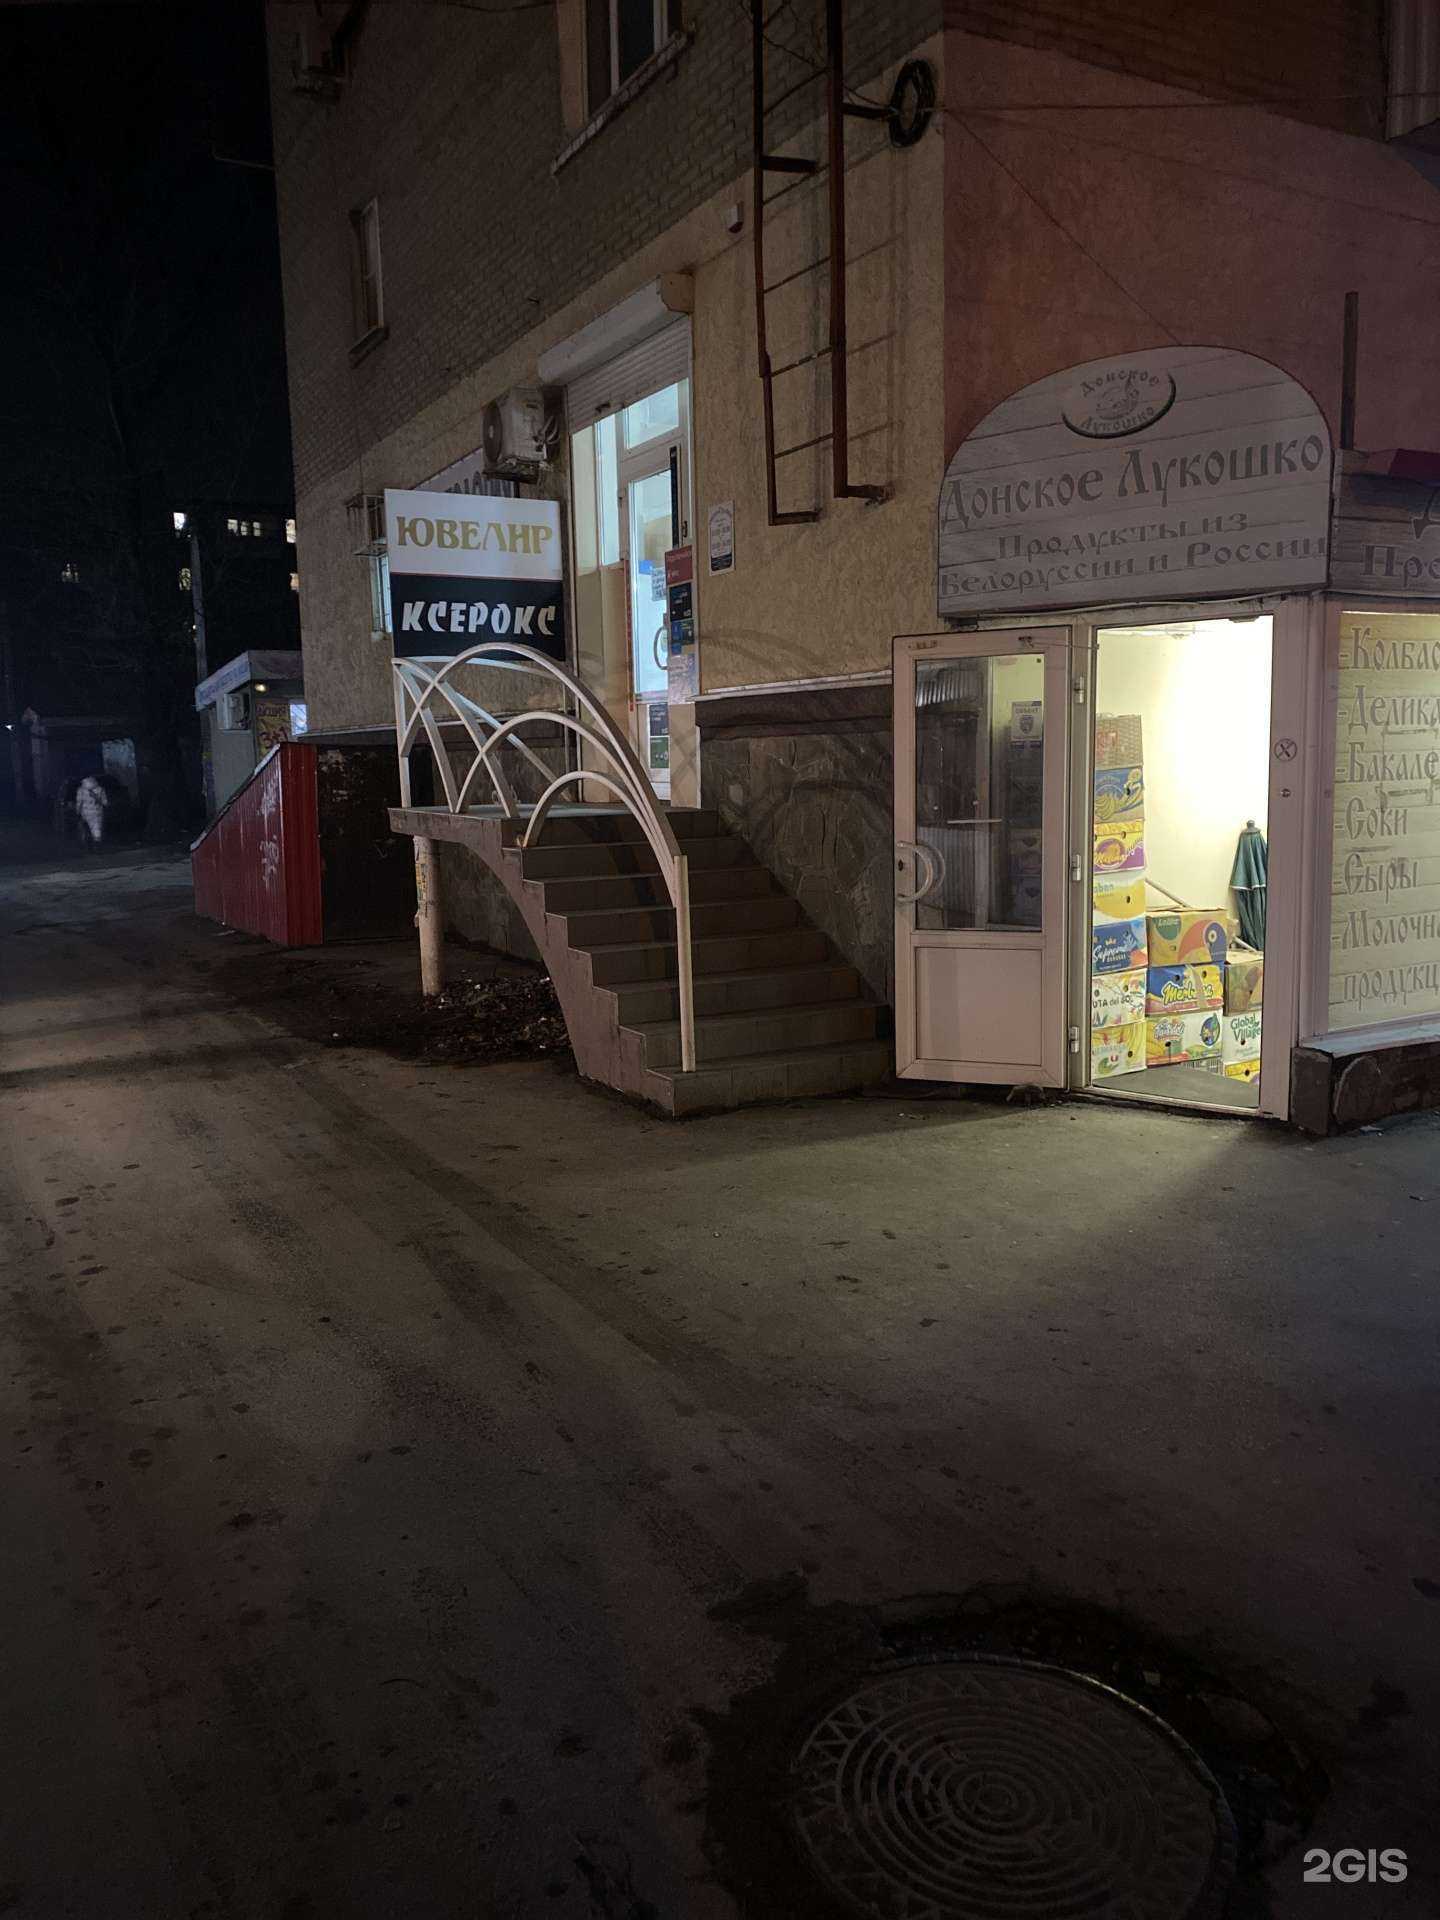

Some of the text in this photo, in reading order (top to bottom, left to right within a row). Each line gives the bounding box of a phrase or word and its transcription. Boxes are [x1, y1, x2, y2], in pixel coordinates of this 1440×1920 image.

[942, 433, 1324, 529] Донское Лукошко
[396, 516, 553, 554] ЮВЕЛИР
[998, 513, 1248, 563] Продукты из
[940, 535, 1326, 596] Белоруссии и России
[401, 601, 557, 636] КСЕРОКС
